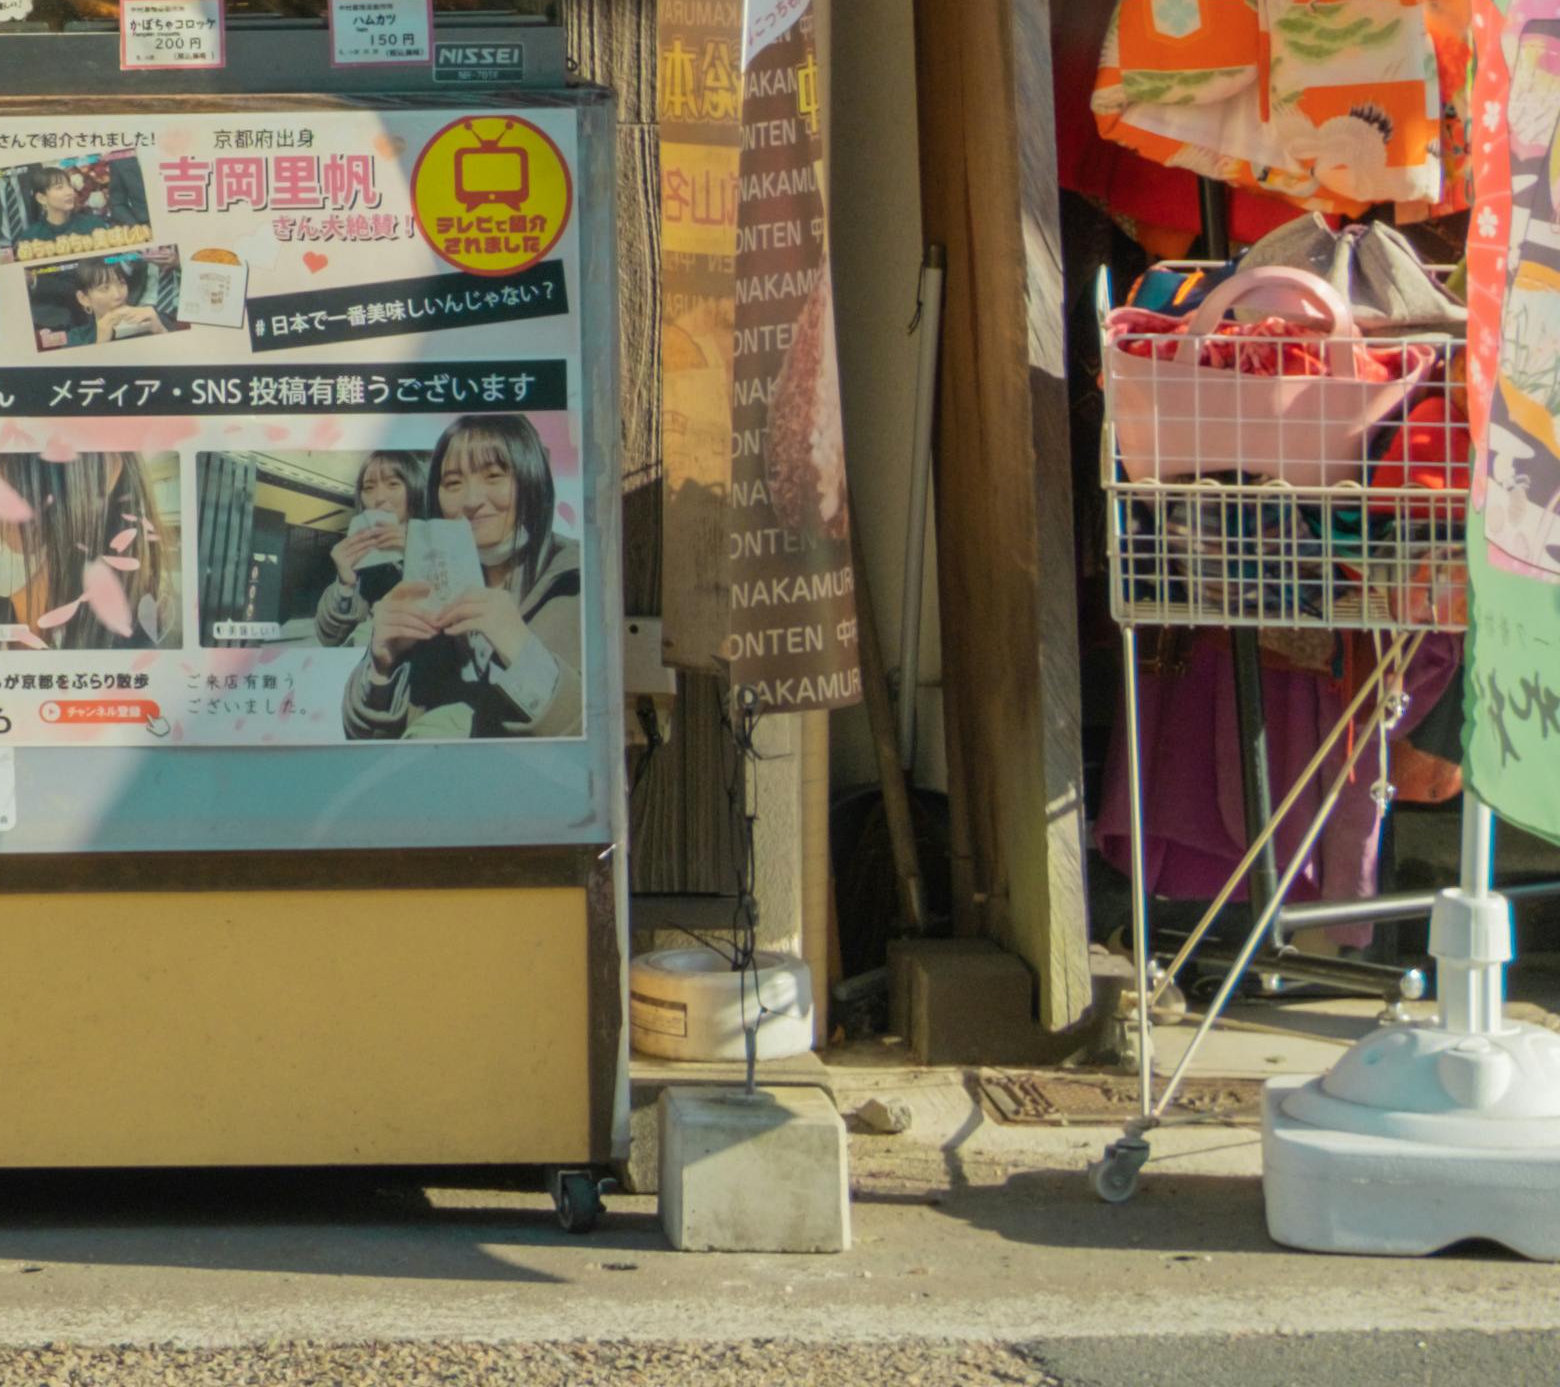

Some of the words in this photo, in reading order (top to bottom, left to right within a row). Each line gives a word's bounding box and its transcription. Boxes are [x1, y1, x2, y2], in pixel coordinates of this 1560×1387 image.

[129, 17, 217, 31] かぼちゃコロッケ
[352, 13, 397, 27] ハムカツ
[154, 37, 201, 51] 200円
[369, 32, 416, 46] 150円
[438, 47, 520, 65] NISSEI
[212, 127, 315, 150] 京都府出身
[158, 153, 382, 215] 吉岡里帆
[271, 215, 417, 243] さん大絶賛!
[435, 215, 548, 236] テレビで紹介
[442, 235, 543, 255] されました
[271, 280, 556, 336] 日本で一番美味しいんじゃない?
[185, 673, 297, 691] ご来店有難う
[66, 705, 143, 720] チャンネル登録
[185, 696, 309, 717] ございました。
